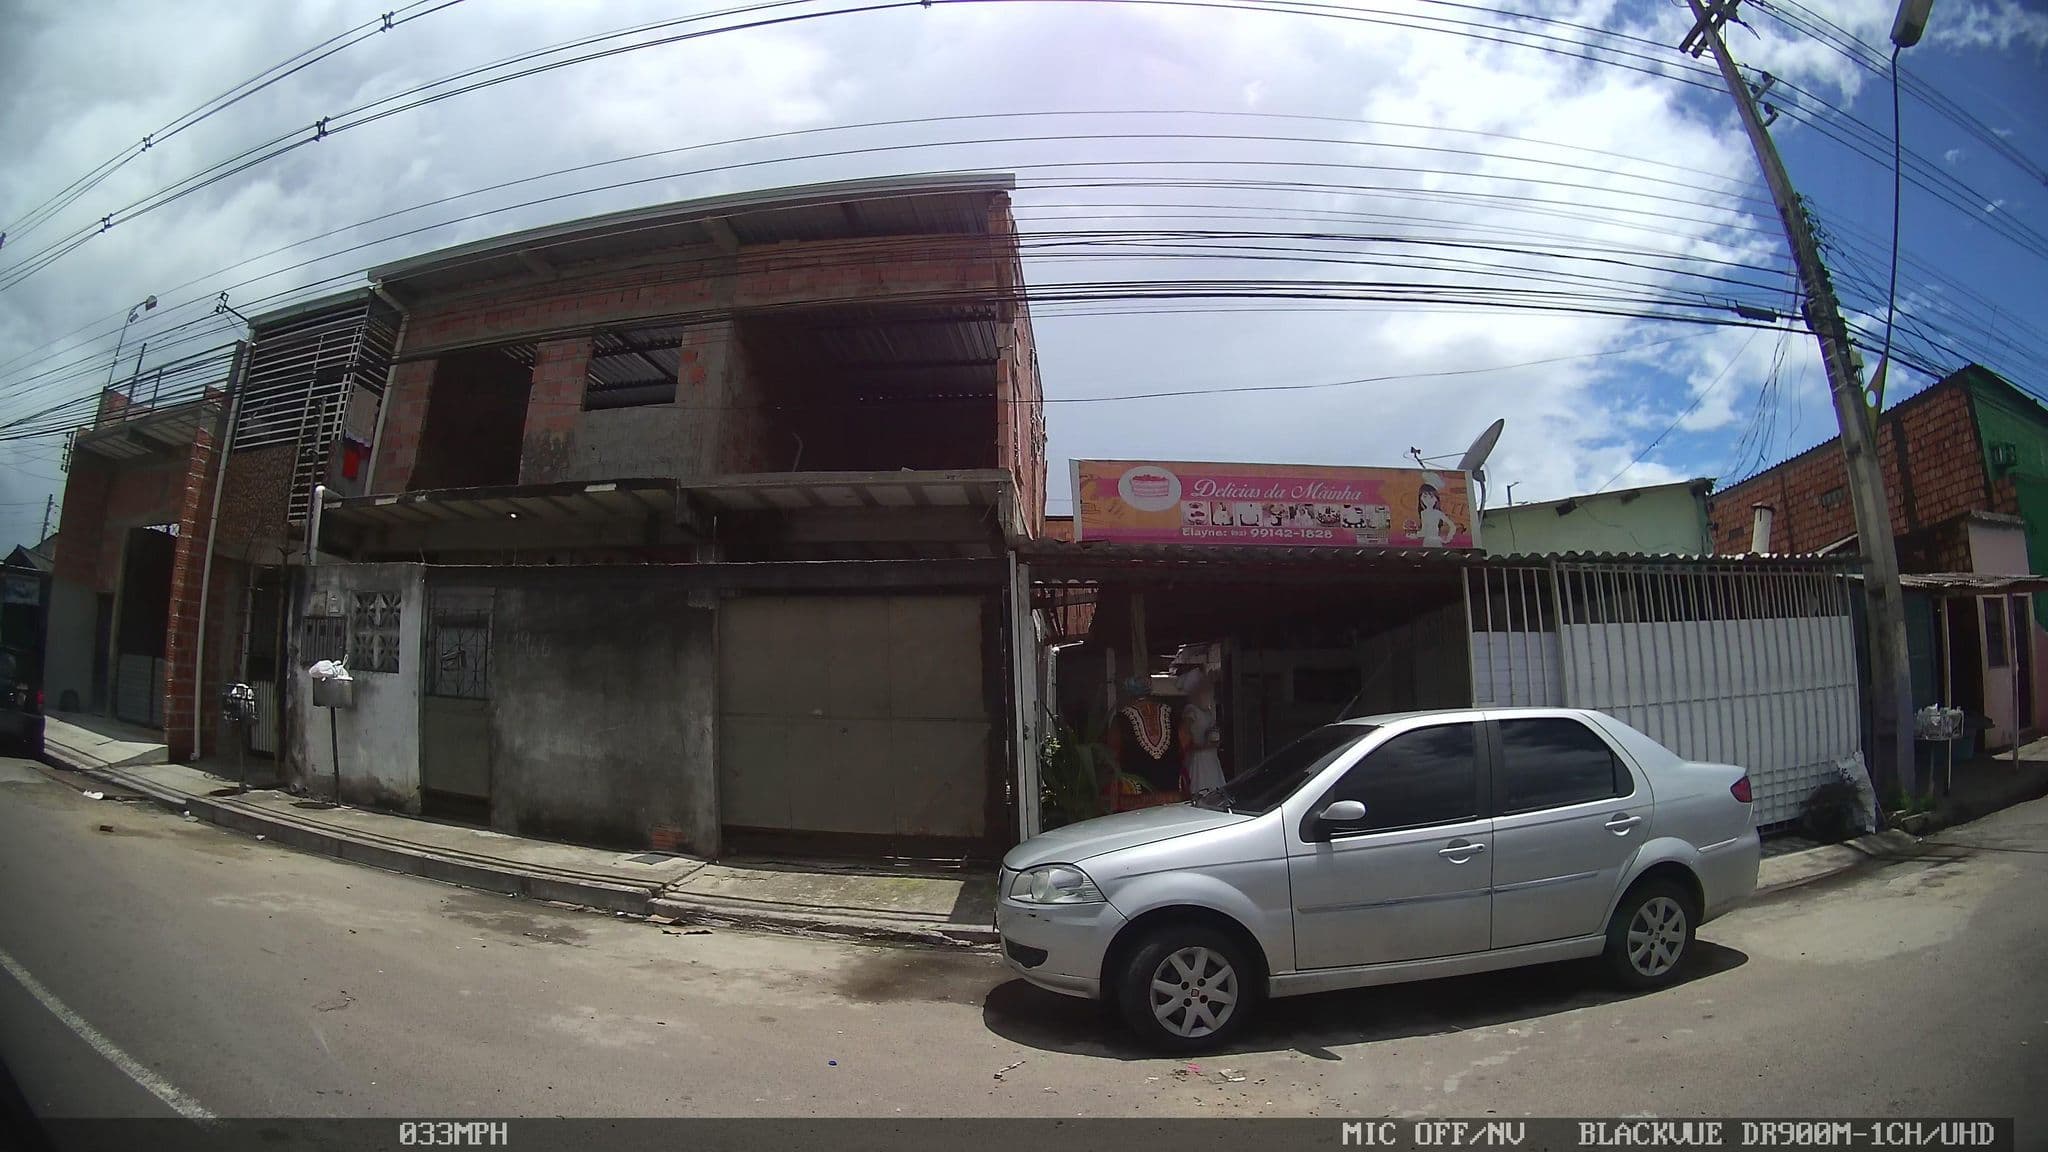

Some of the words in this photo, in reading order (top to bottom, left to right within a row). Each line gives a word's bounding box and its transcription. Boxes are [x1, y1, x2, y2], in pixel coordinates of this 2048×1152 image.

[1264, 482, 1286, 499] da
[1182, 528, 1227, 538] Elayne:
[1250, 528, 1333, 540] 99142-1828
